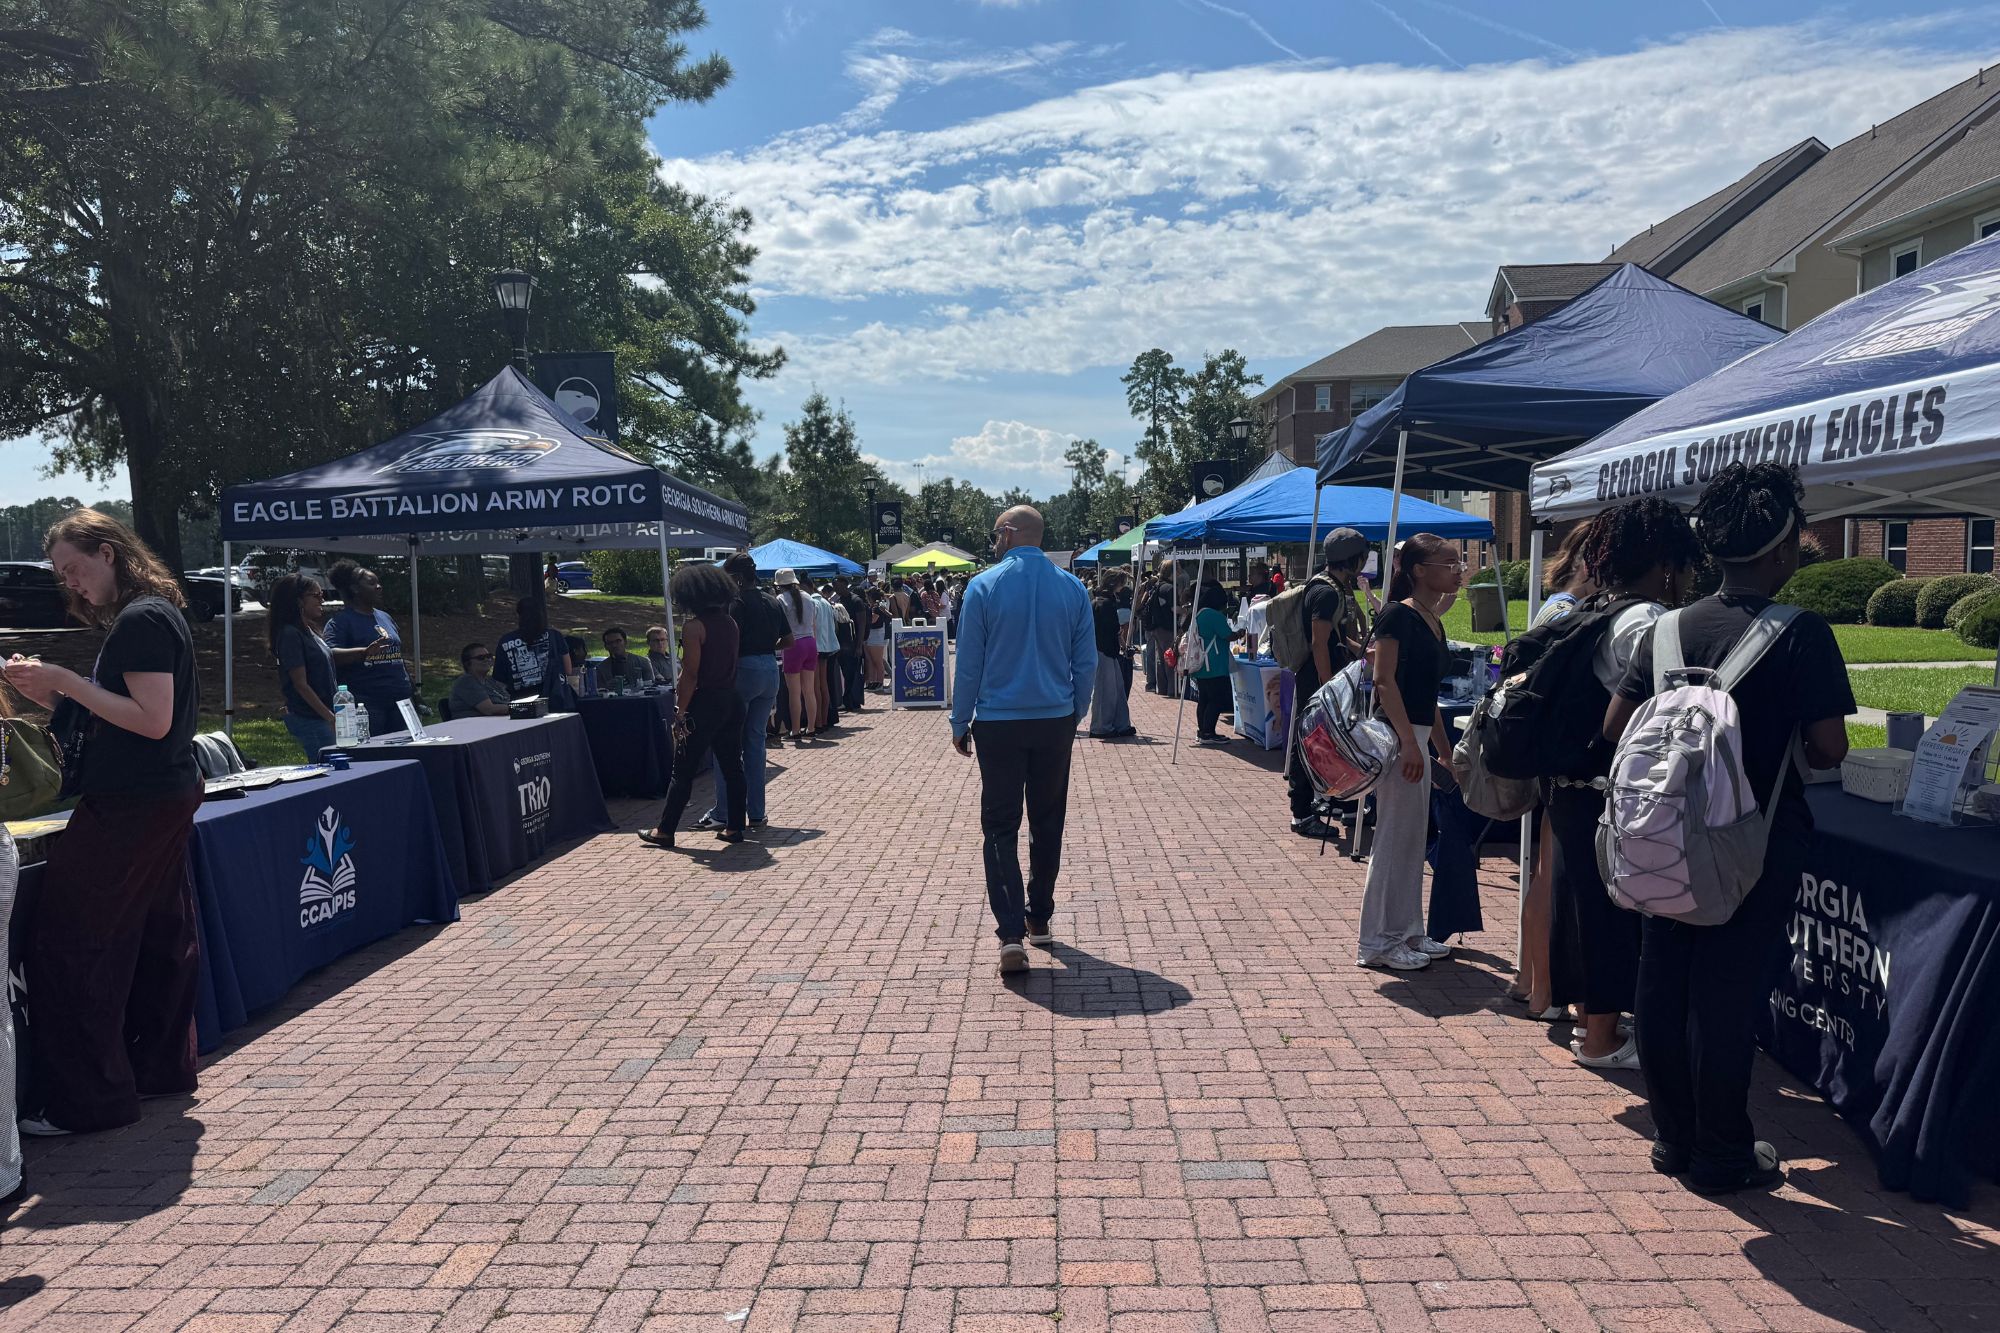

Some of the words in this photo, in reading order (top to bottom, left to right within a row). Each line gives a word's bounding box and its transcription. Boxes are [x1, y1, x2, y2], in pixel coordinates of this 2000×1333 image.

[1596, 447, 1679, 502] GEORGIA
[1683, 414, 1817, 488] SOUTHERN
[1821, 385, 1946, 463] EAGLES
[233, 499, 323, 522] EAGLE
[330, 492, 478, 520] BATTALION
[485, 487, 564, 512] ARMY
[572, 483, 646, 507] ROTC
[661, 484, 693, 513] GEORGIA
[692, 496, 722, 523] SOUTHERN
[721, 508, 735, 527] ARMY
[734, 513, 748, 532] ROTC
[911, 659, 927, 670] HIS
[911, 667, 928, 675] radio
[904, 686, 936, 697] HERE
[1795, 872, 1869, 933] RGIA
[1786, 911, 1891, 991] UTHERN
